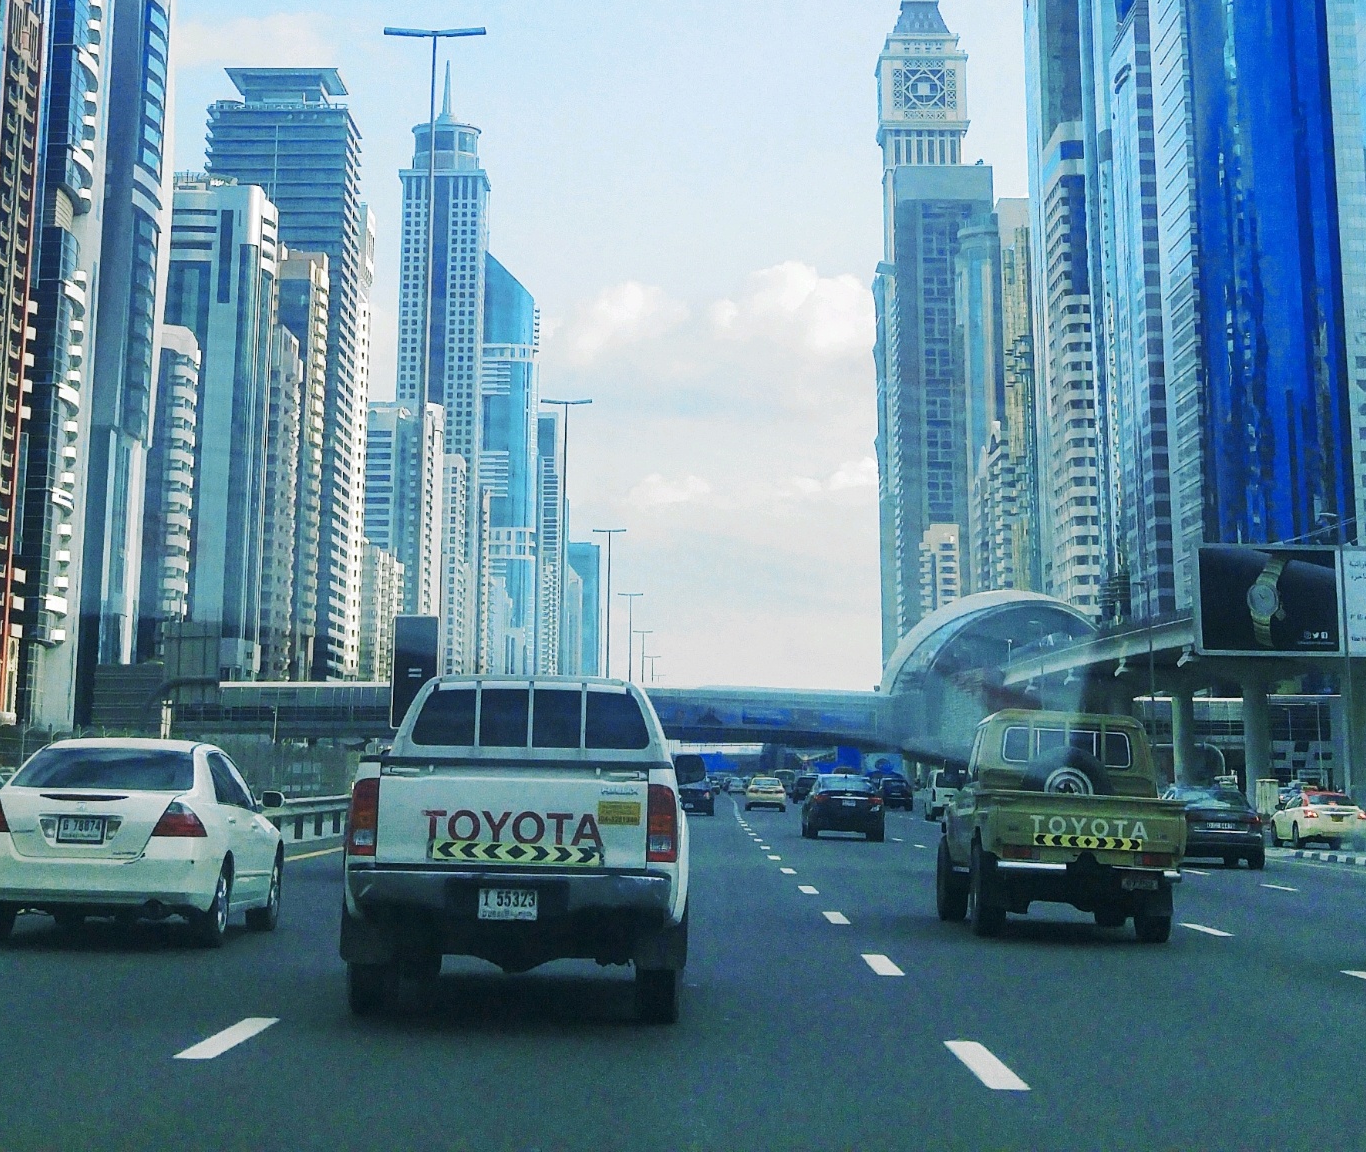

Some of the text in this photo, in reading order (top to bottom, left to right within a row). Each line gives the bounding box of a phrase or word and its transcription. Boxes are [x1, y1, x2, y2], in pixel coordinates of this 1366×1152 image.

[423, 809, 603, 847] TOYOTA
[1030, 815, 1149, 840] TOYOTA
[496, 890, 536, 908] 55323
